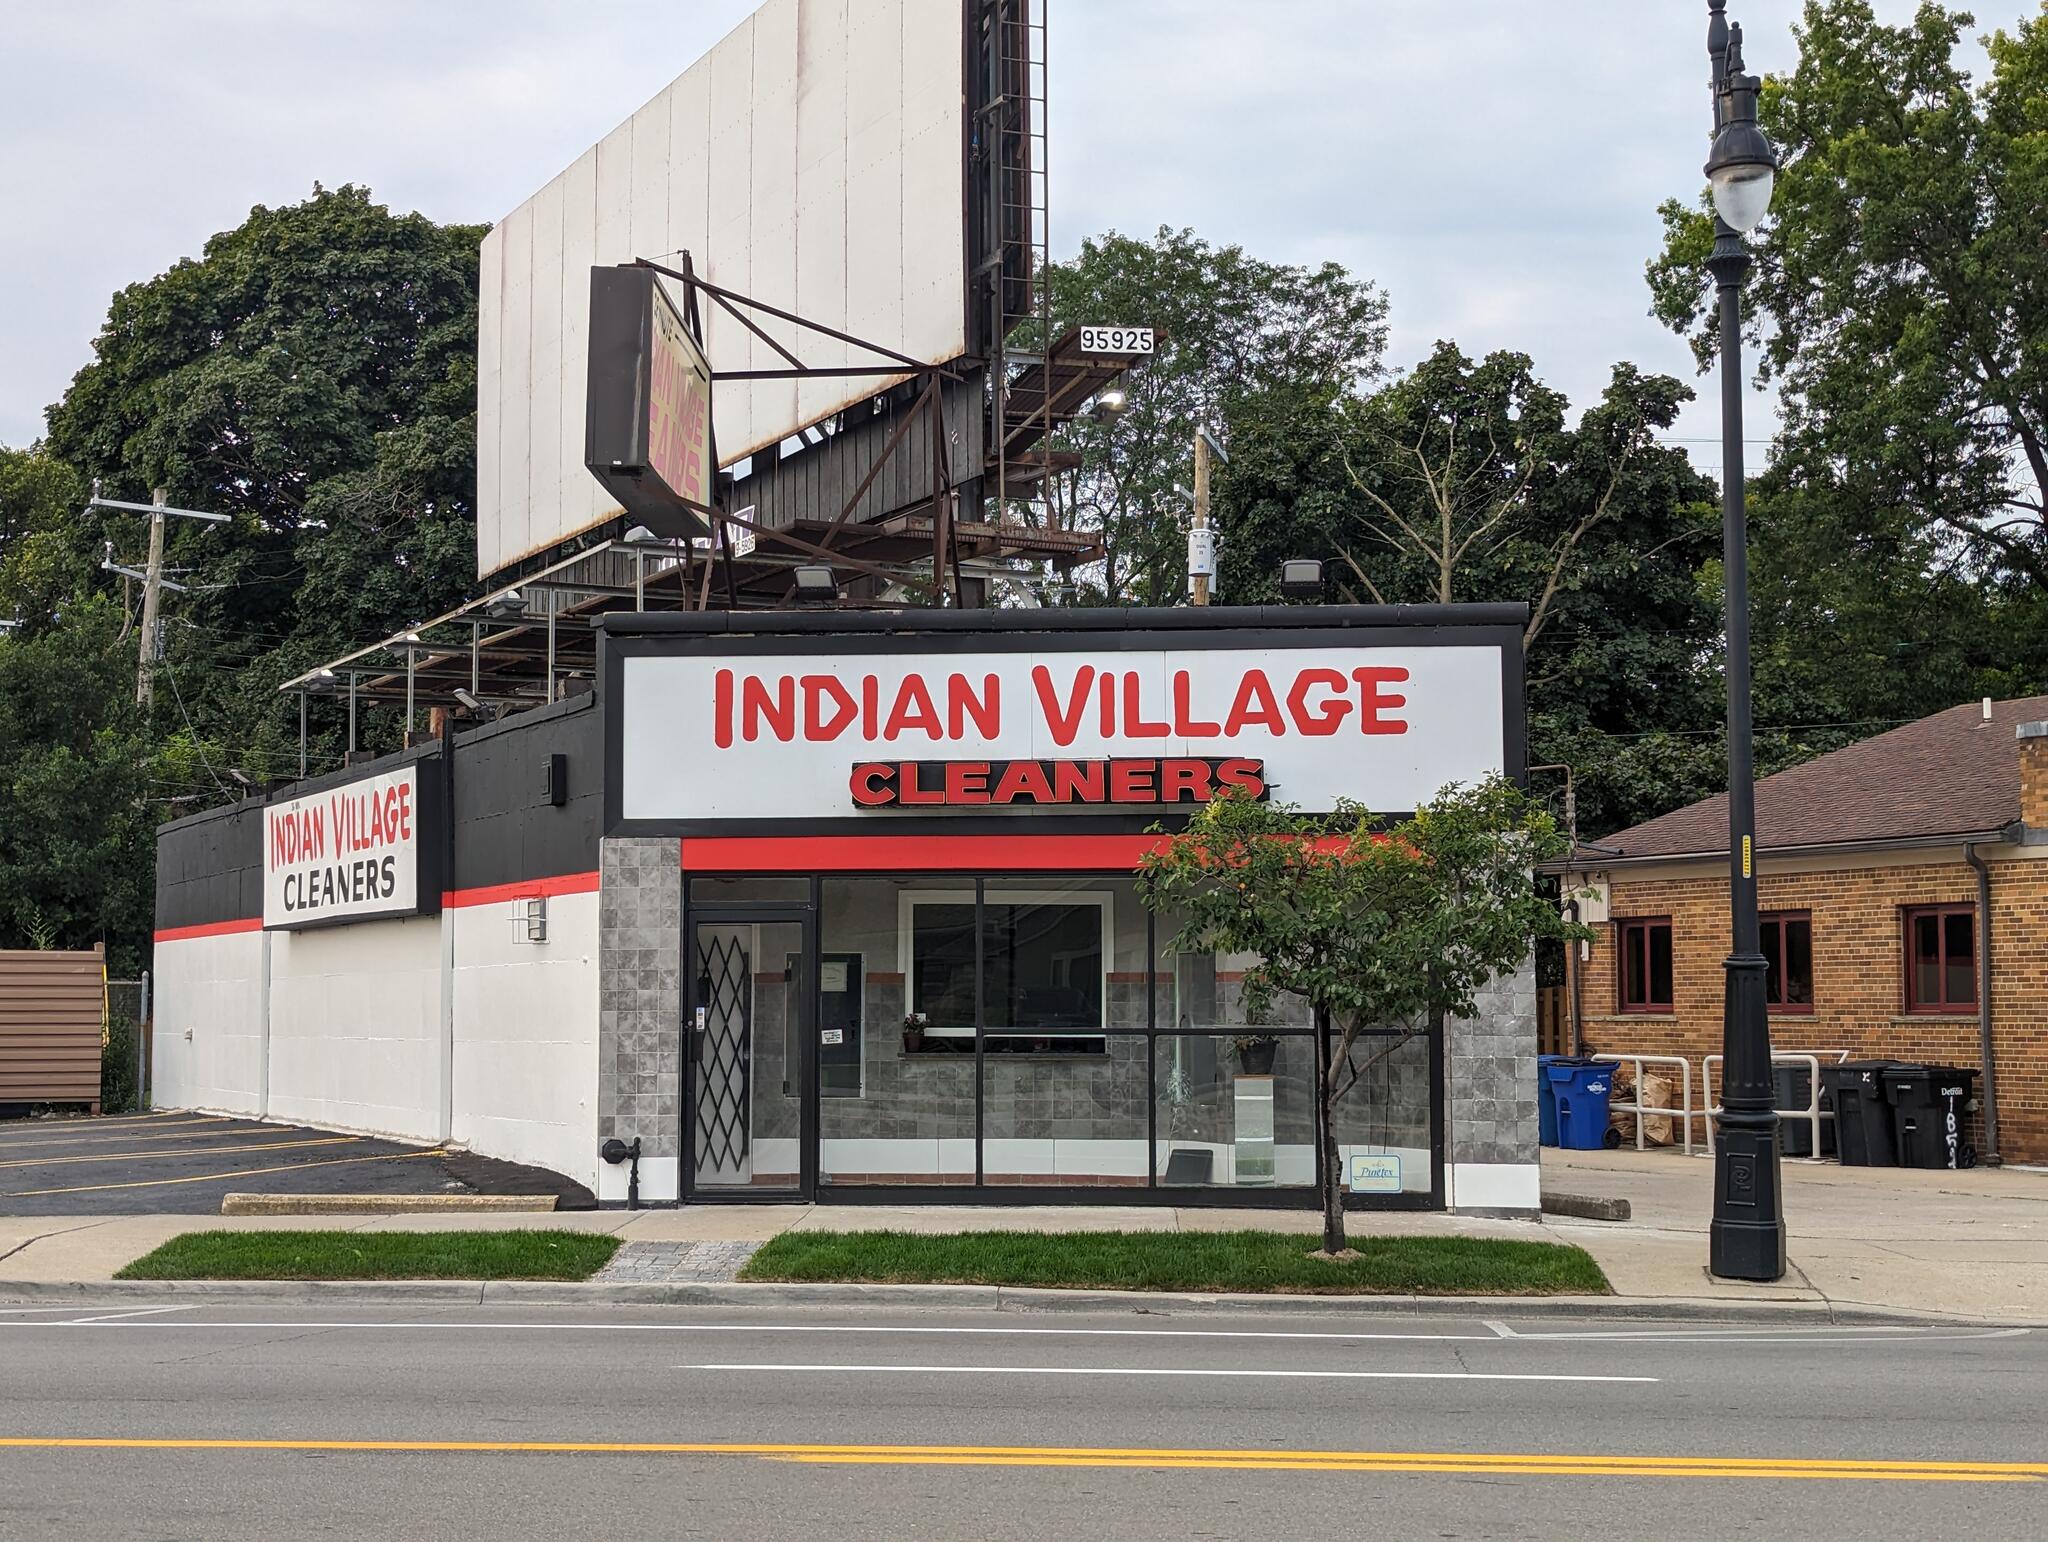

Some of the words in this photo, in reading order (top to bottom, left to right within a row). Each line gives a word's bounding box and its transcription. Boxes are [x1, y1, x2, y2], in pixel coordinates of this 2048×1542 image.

[1082, 329, 1152, 351] 95925
[715, 669, 1000, 749] INDIAN
[1032, 665, 1410, 747] VILLAGE
[849, 758, 1264, 805] CLEANERS
[271, 804, 324, 873] INDIAN
[331, 783, 411, 860] VILLAGE
[284, 855, 395, 912] CLEANERS
[1941, 1087, 1963, 1096] Detroit
